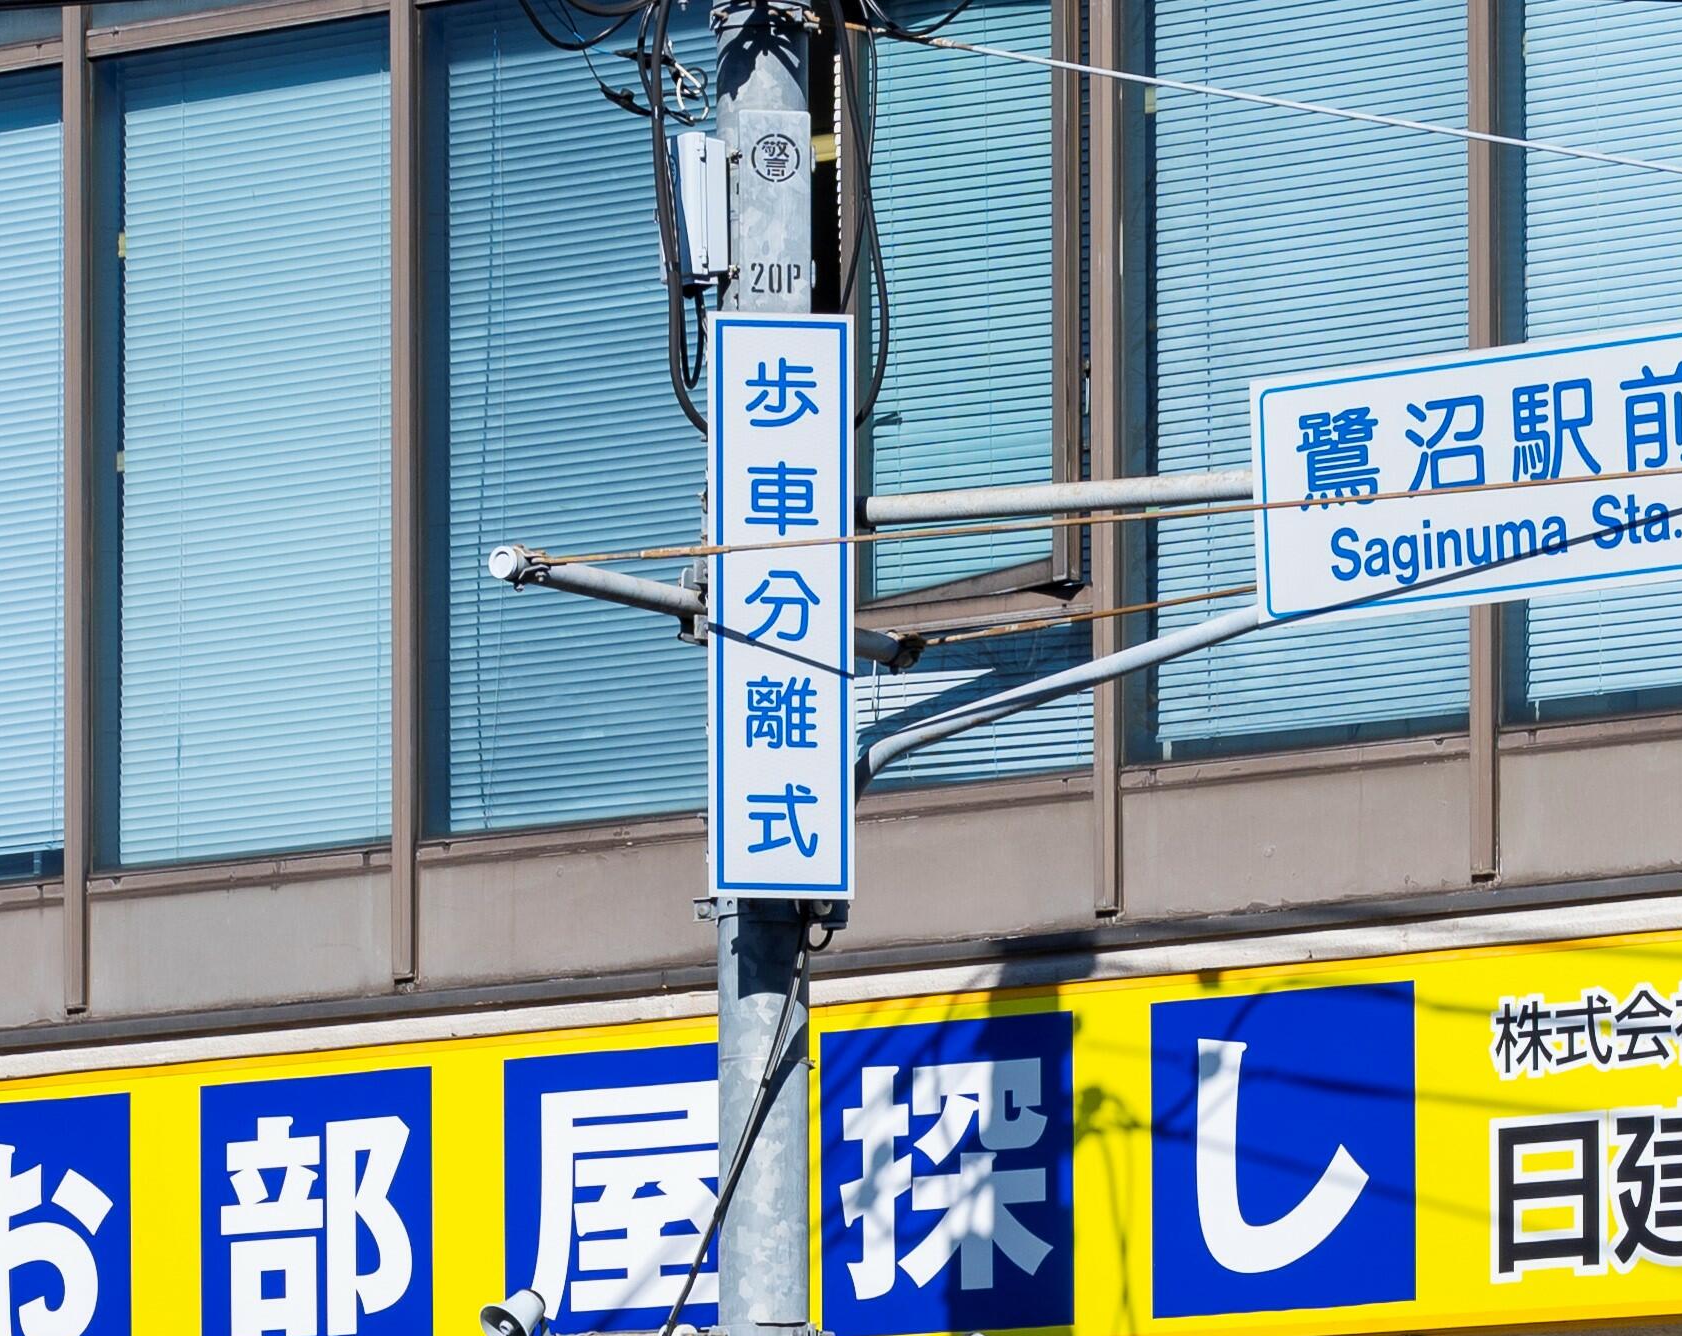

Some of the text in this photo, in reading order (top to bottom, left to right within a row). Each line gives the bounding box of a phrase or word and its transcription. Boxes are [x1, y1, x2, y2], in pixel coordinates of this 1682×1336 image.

[749, 262, 803, 295] 20P
[1330, 512, 1570, 586] Saginuma
[745, 357, 820, 859] 歩車分離式
